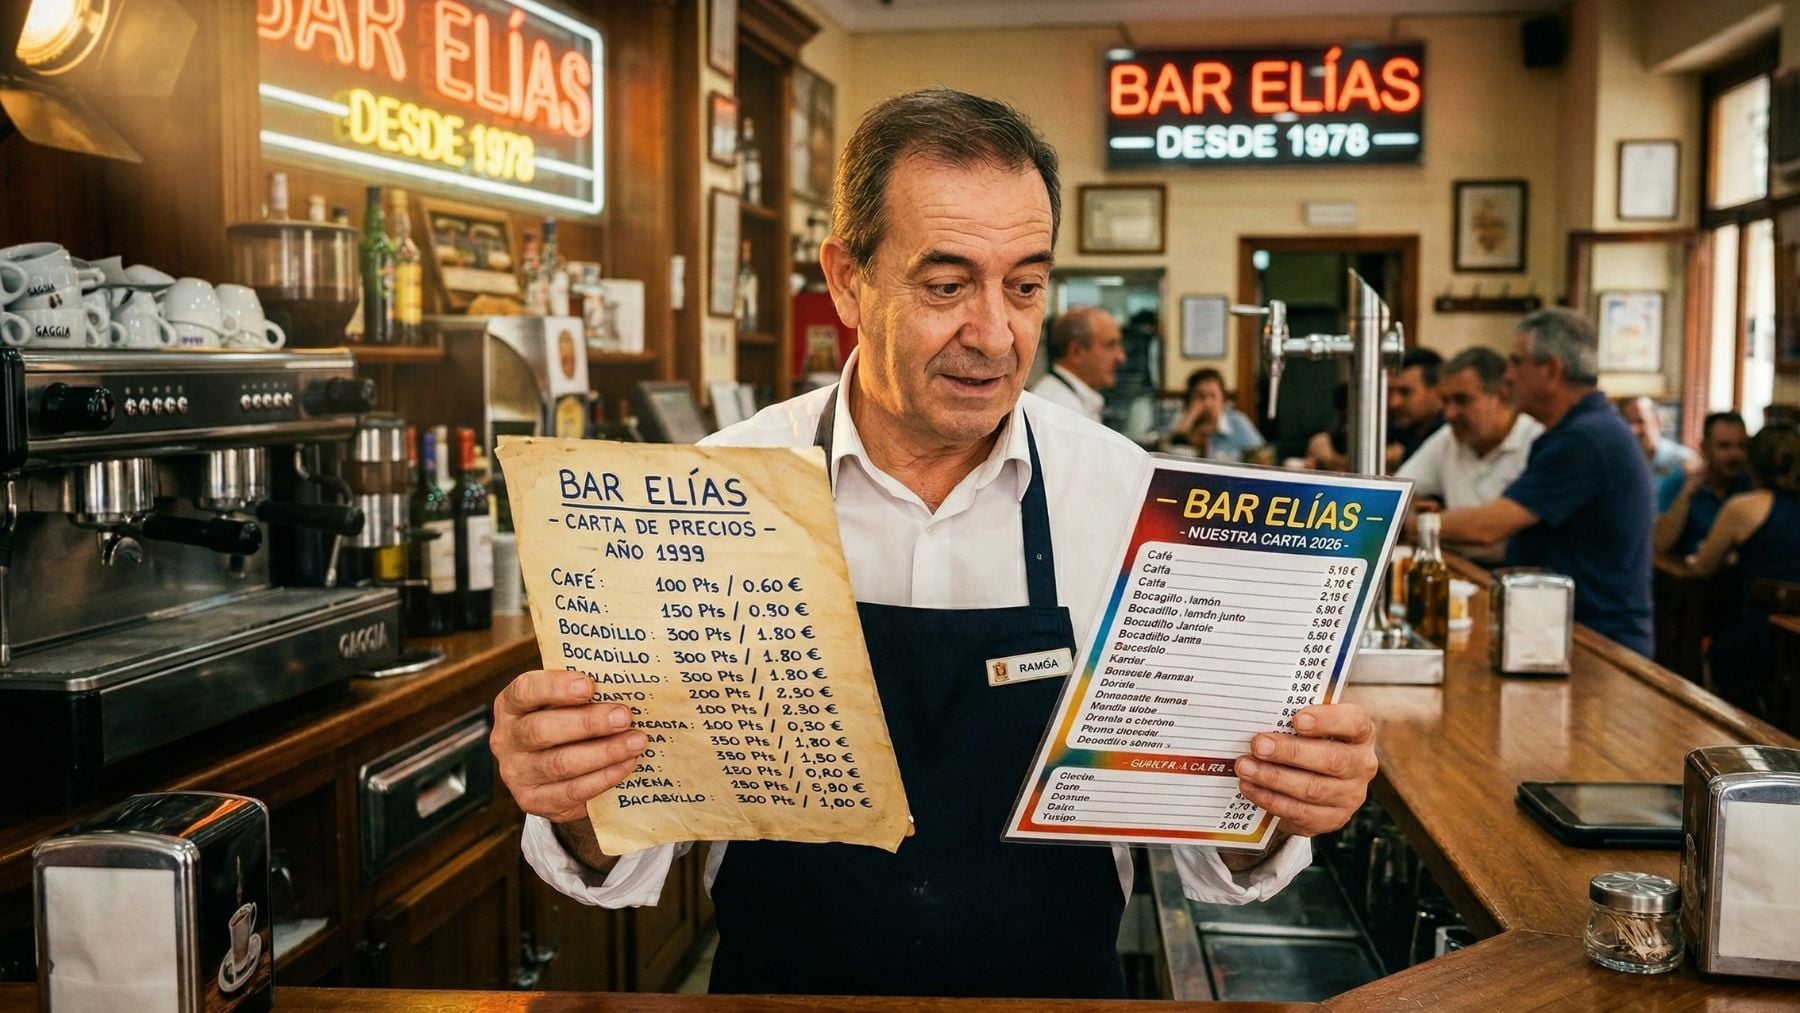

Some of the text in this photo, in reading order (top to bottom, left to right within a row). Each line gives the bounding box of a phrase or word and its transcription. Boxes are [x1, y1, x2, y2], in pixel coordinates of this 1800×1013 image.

[435, 0, 592, 138] ELÍAS
[1109, 46, 1421, 116] BAR ELÍAS
[349, 87, 536, 183] DESDE 1978
[1156, 122, 1370, 159] DESDE 1978
[35, 325, 71, 337] GAGGIA
[559, 467, 748, 507] BAR ELÍAS
[1183, 488, 1361, 532] BAR ELÍAS
[565, 513, 756, 537] CARTA DE PRECIOS
[1188, 526, 1257, 544] NUESTRA
[1261, 533, 1306, 549] CARTA
[605, 539, 705, 562] AÑO 1999
[1147, 550, 1173, 561] Café
[656, 577, 687, 592] 100
[693, 577, 720, 593] Pts
[743, 578, 784, 593] 0.60
[661, 603, 692, 618] 150
[698, 603, 726, 618] Pts
[667, 628, 699, 641] 300
[705, 627, 732, 641] Pts
[757, 627, 796, 641] 1.80
[673, 651, 706, 664] 300
[711, 650, 738, 663] Pts
[763, 649, 802, 663] 1.80
[680, 671, 713, 683] 300
[717, 670, 744, 683] Pts
[689, 689, 720, 699] 200
[724, 687, 751, 699] Pts
[696, 704, 726, 715] 100
[731, 703, 758, 715] Pts
[703, 720, 733, 731] 100
[737, 719, 764, 731] Pts
[710, 735, 740, 746] 350
[745, 735, 771, 747] Pts
[716, 751, 746, 761] 350
[751, 750, 777, 762] Pts
[757, 765, 782, 776] Pts
[764, 780, 789, 792] Pts
[771, 795, 796, 805] Pts
